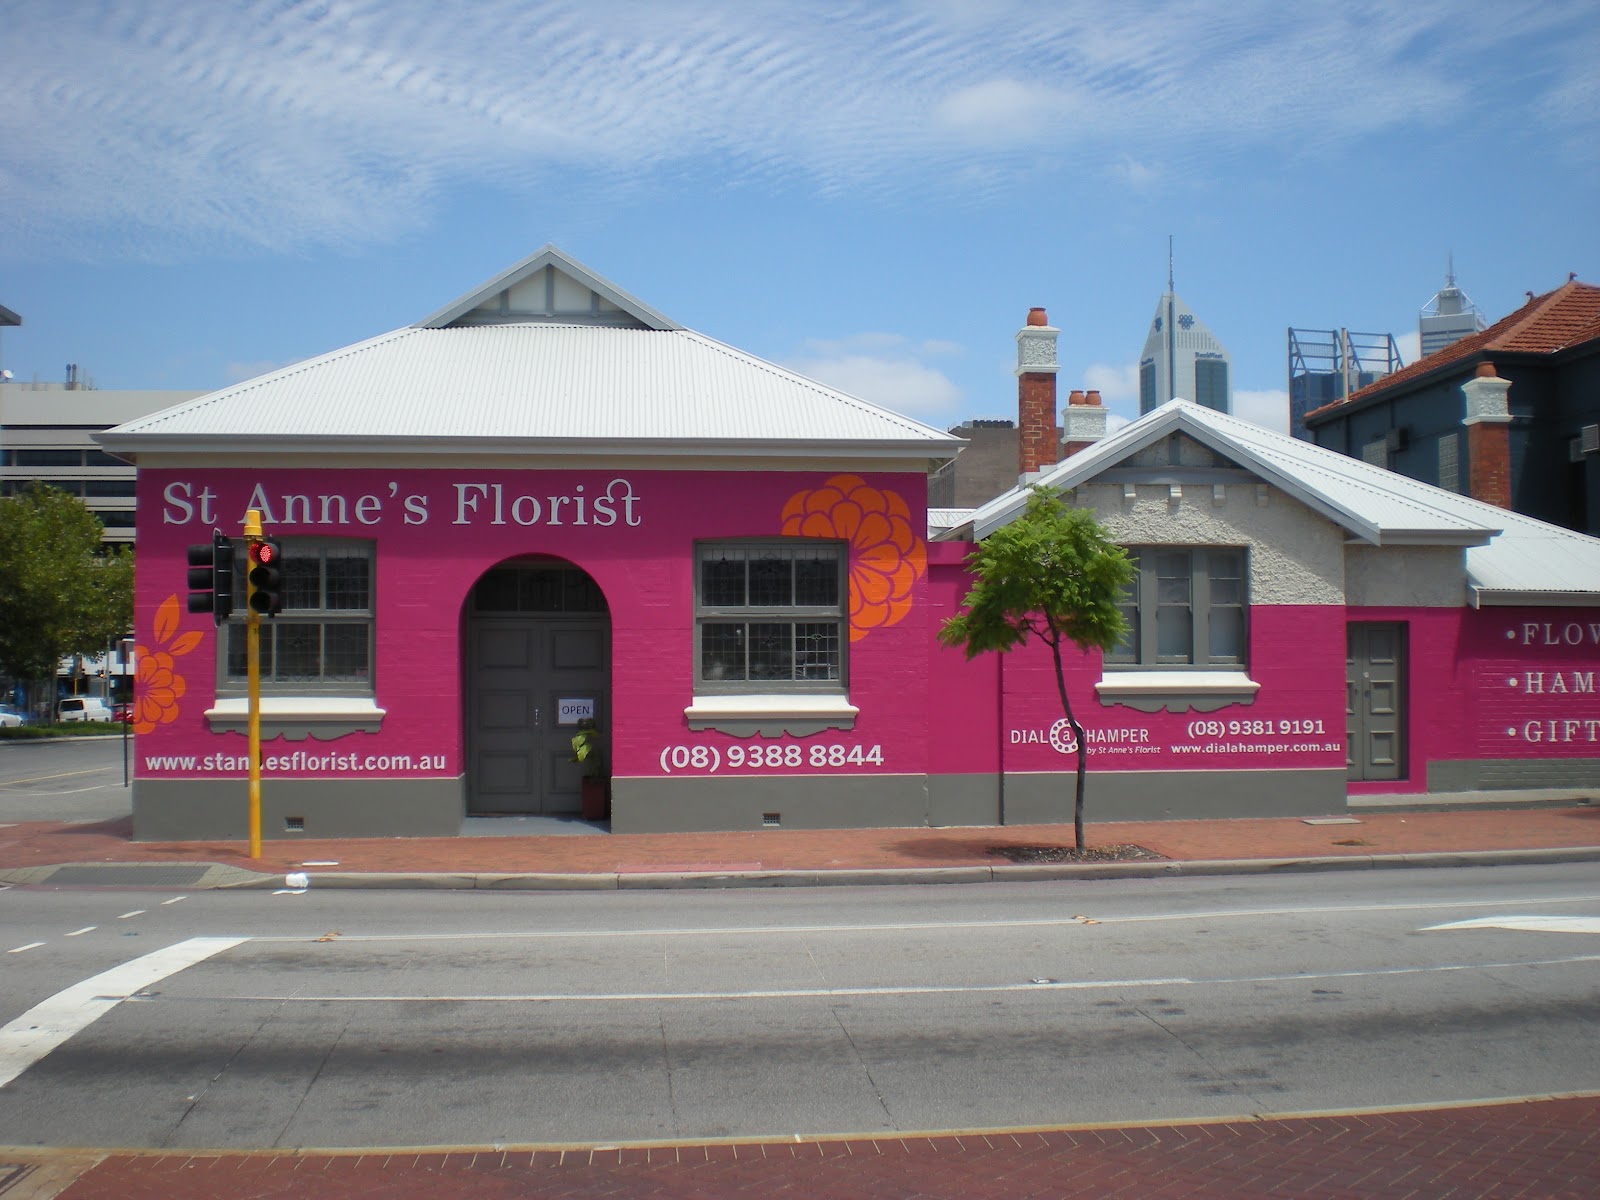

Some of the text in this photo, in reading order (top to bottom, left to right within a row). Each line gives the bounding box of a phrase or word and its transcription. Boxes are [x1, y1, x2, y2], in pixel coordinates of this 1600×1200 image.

[163, 478, 642, 527] St Anne's Florist
[1524, 671, 1596, 694] HAM
[561, 705, 590, 715] OPEN
[1010, 728, 1149, 744] DIAL a HAMPER
[1187, 719, 1326, 739] (08) 9381 9191
[1524, 719, 1600, 743] GIFT
[1086, 745, 1161, 756] by St Anne's Florist
[1170, 742, 1341, 755] www.dialahamper.com.au
[145, 751, 446, 771] www.stanesflorist.com.au
[659, 744, 885, 774] (08) 9388 8844
